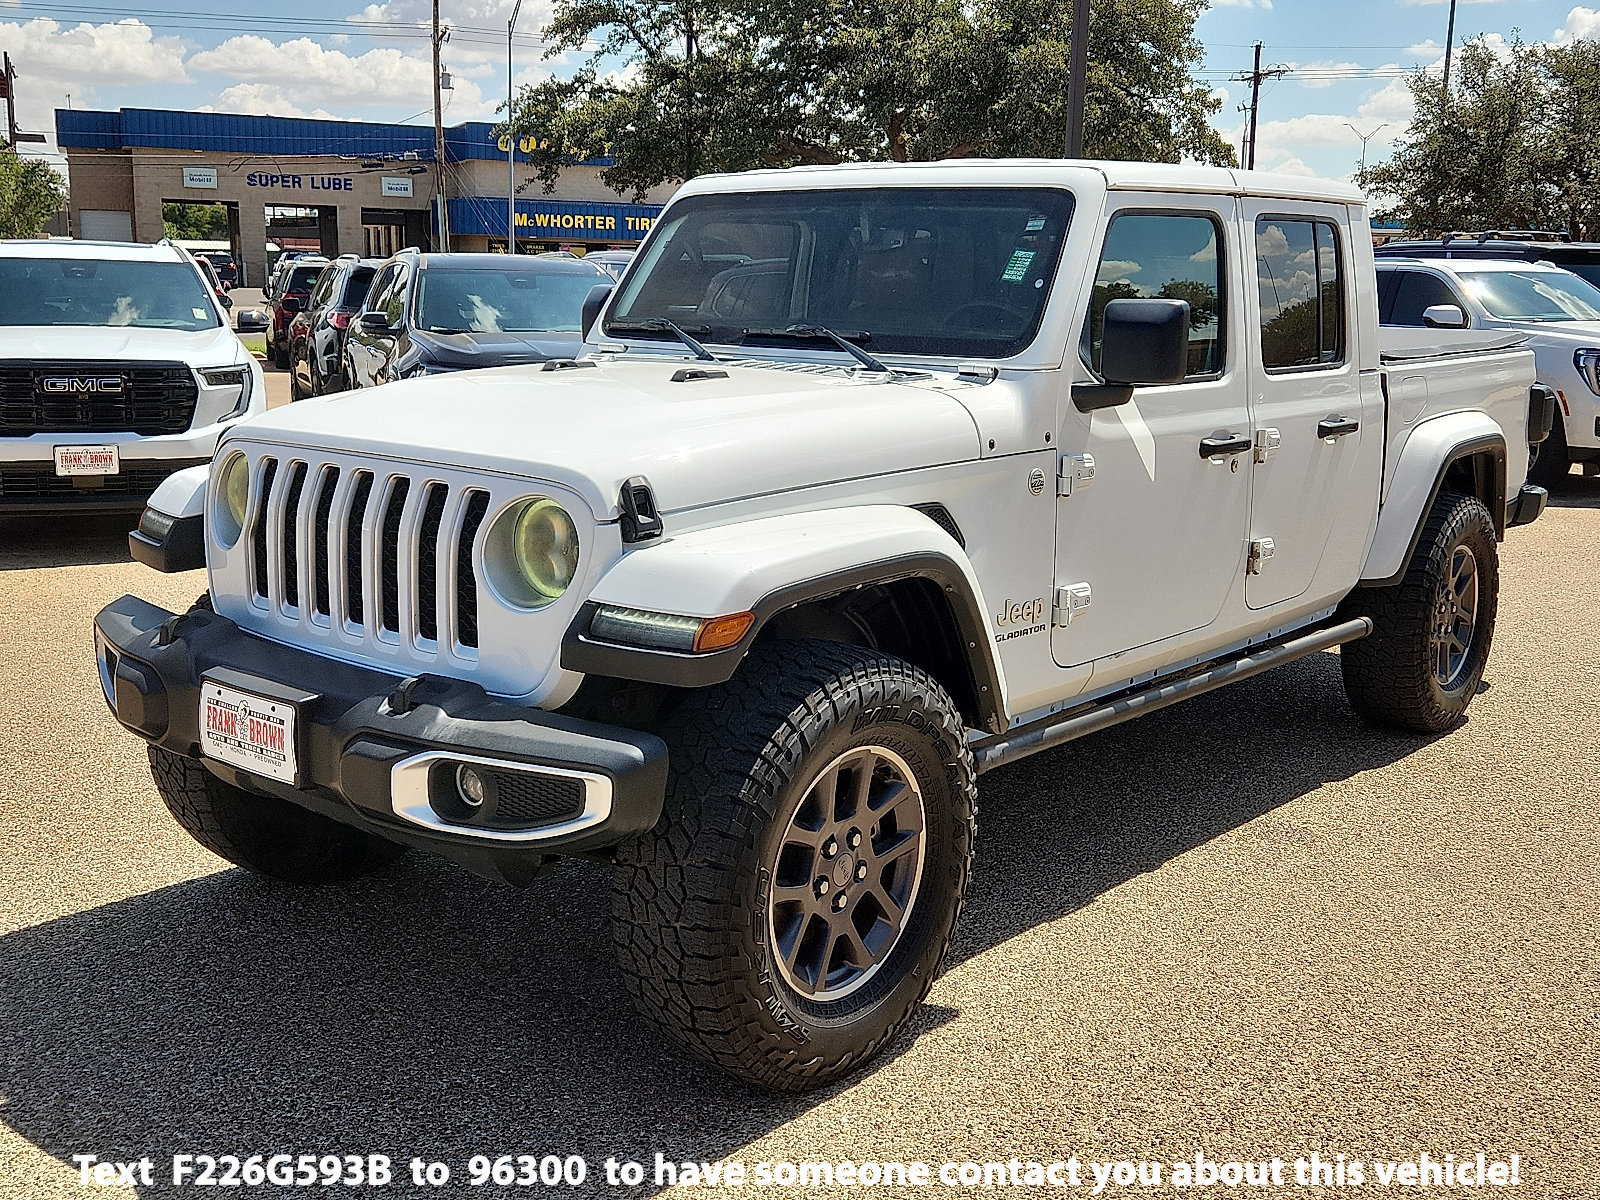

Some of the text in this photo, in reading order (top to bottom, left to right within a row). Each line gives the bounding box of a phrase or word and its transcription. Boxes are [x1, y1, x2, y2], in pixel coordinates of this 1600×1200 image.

[246, 173, 353, 191] SUPER LUBE
[514, 212, 616, 230] McWHORTER
[43, 378, 122, 392] GMC
[60, 455, 114, 464] FRANK BROWN
[996, 598, 1045, 628] Jeep
[994, 623, 1047, 643] GLADIATOR
[207, 705, 285, 753] FRANK BROWN
[850, 705, 964, 808] WILDPEAK
